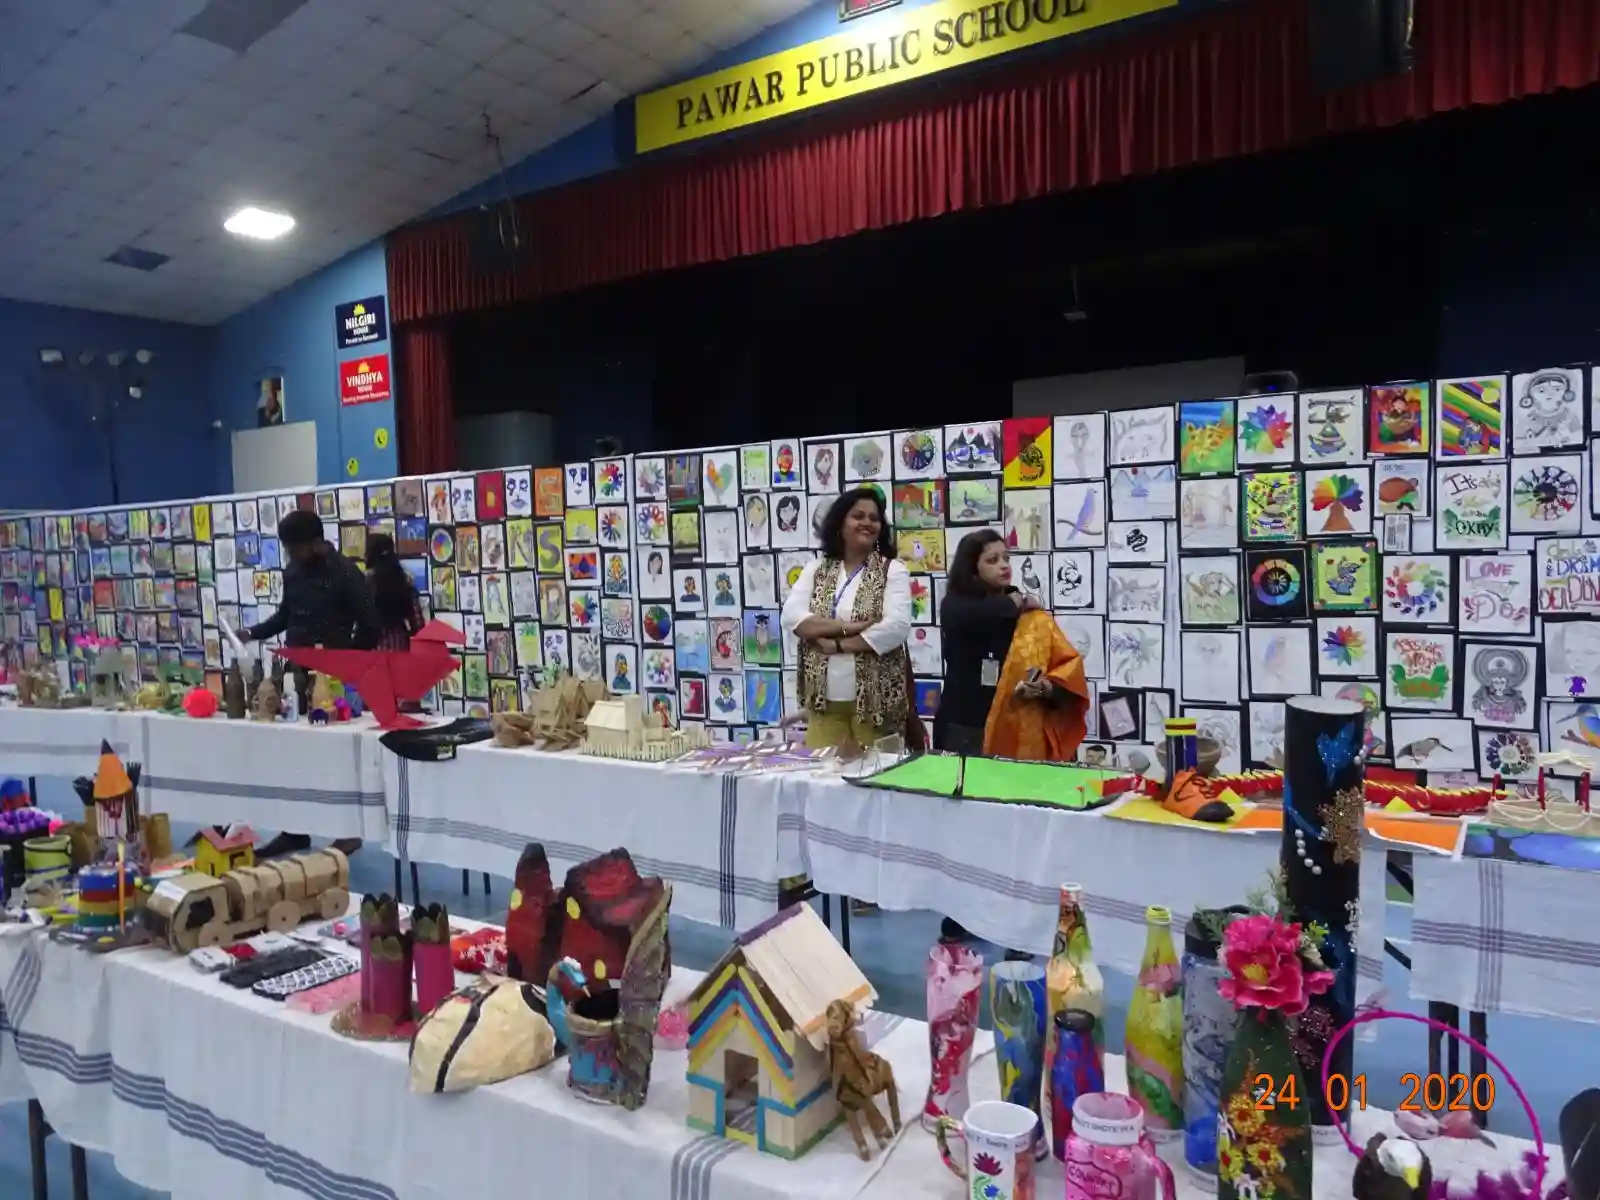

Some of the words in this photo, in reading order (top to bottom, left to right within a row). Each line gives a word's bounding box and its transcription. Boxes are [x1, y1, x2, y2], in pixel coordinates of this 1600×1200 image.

[677, 70, 785, 129] PAWAR
[796, 29, 921, 96] PUBLIC
[933, 0, 1087, 55] SCHOOL
[345, 312, 376, 330] NILGIRI
[346, 371, 384, 388] VINDHYA
[1466, 559, 1515, 582] LOVE
